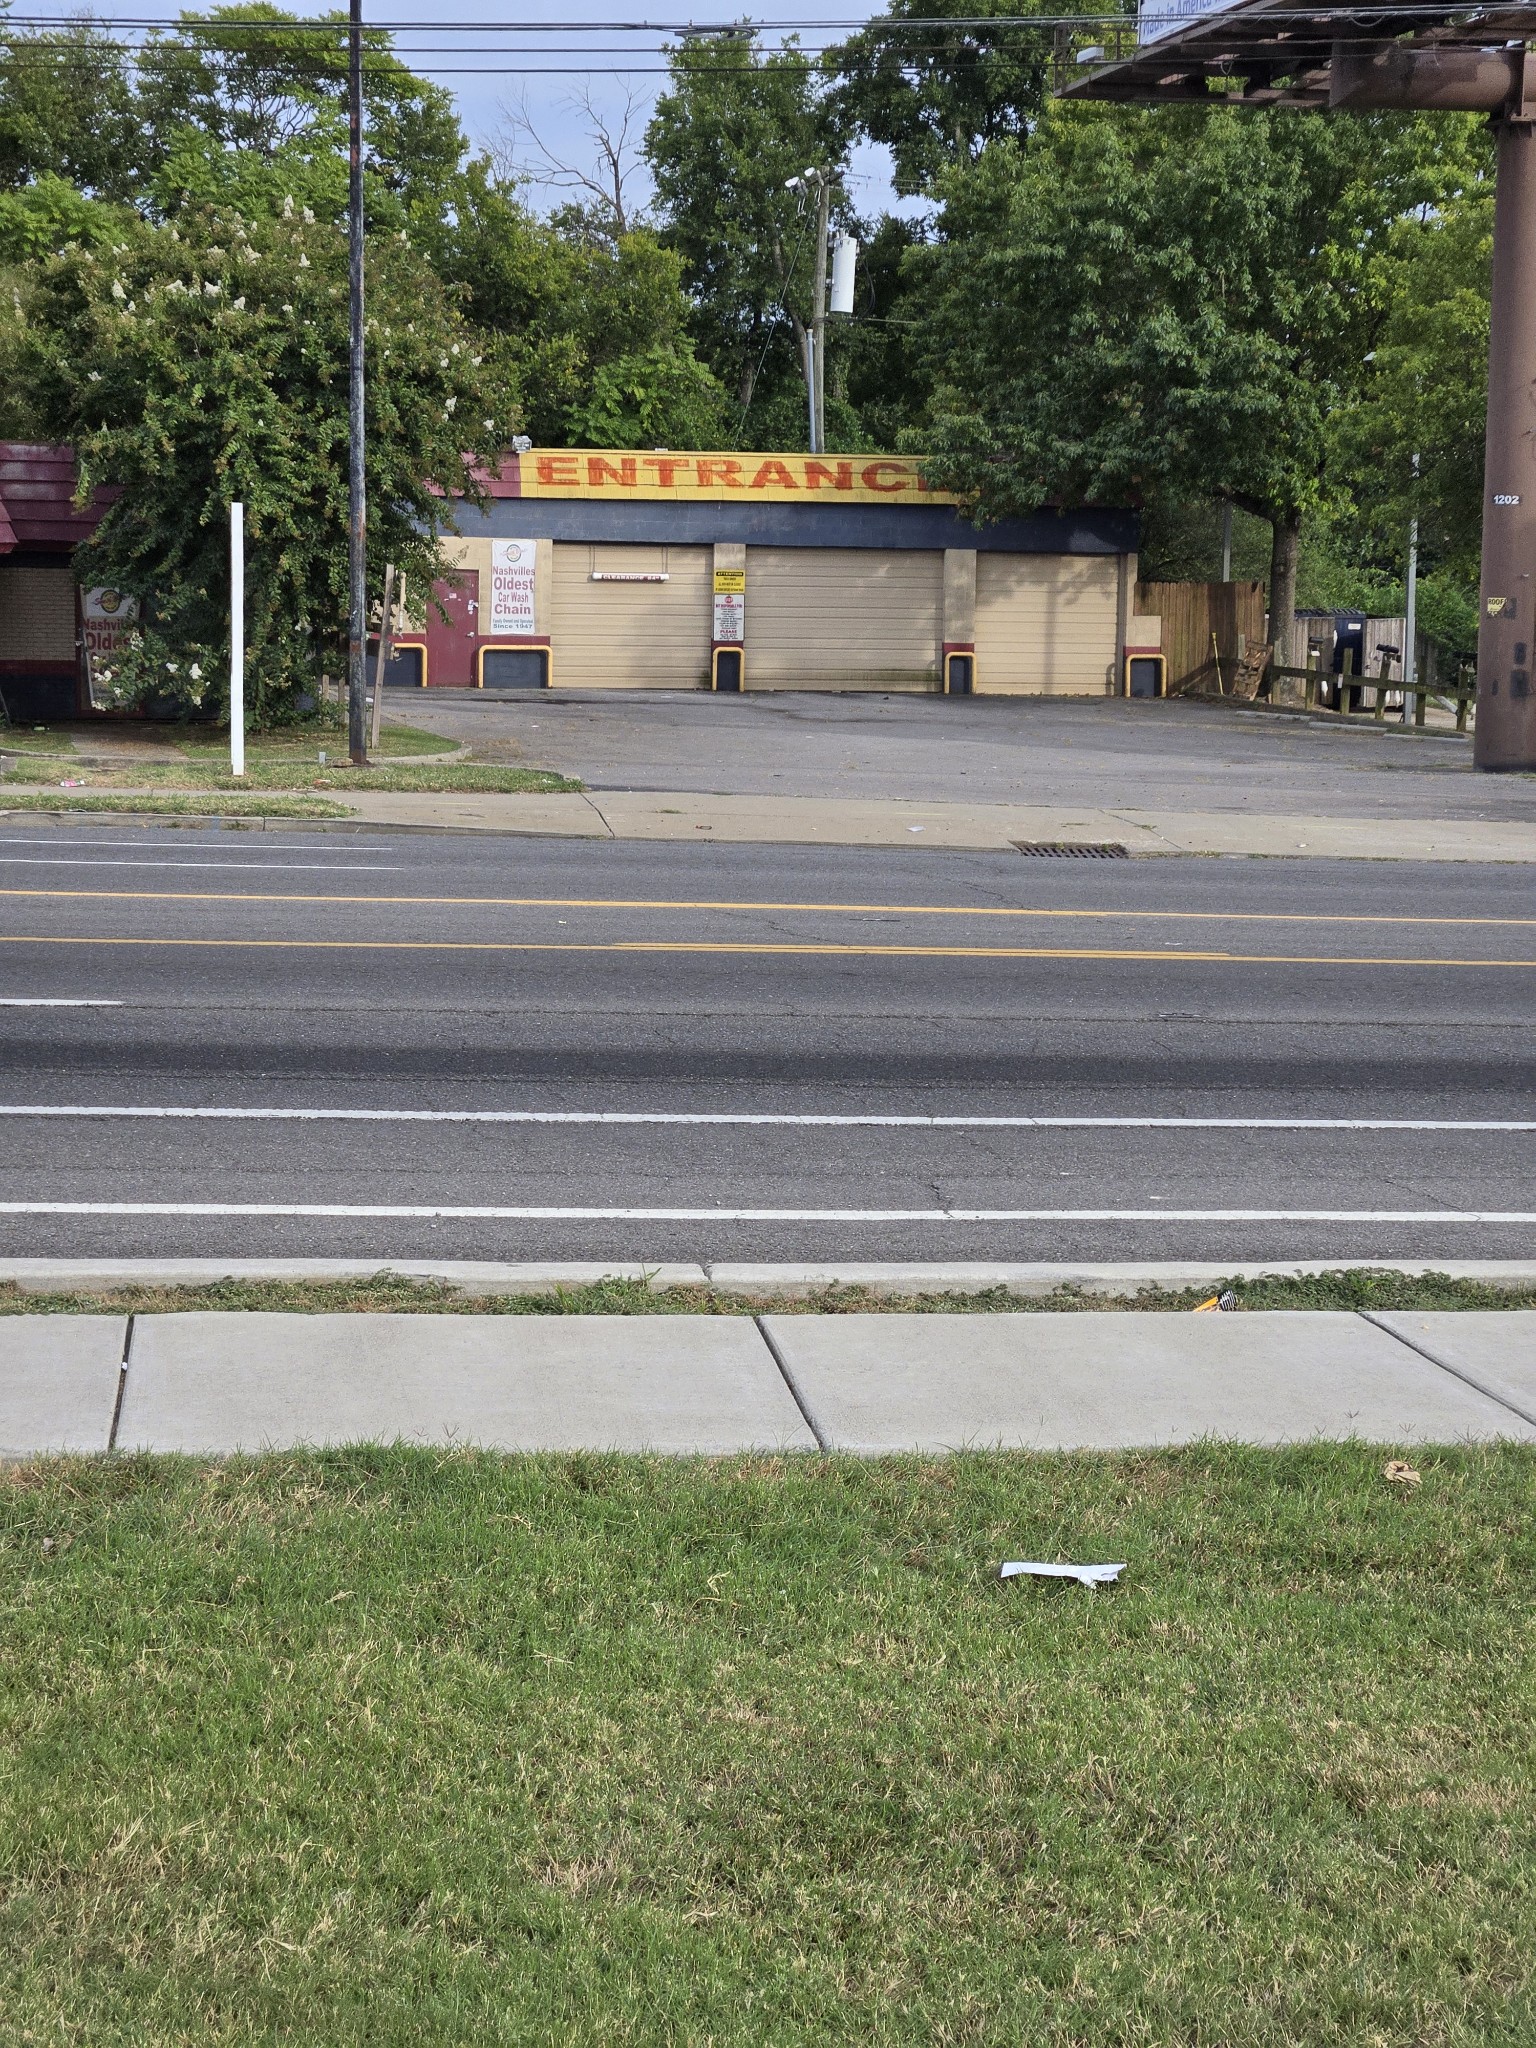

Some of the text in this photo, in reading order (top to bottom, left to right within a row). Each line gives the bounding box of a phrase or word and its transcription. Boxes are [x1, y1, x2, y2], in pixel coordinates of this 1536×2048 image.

[1143, 0, 1211, 35] Made in America
[1493, 494, 1520, 505] 1202
[492, 565, 536, 576] Nashvilles
[493, 576, 534, 591] Oldest
[498, 591, 529, 603] Car Wash
[494, 603, 531, 615] Chain
